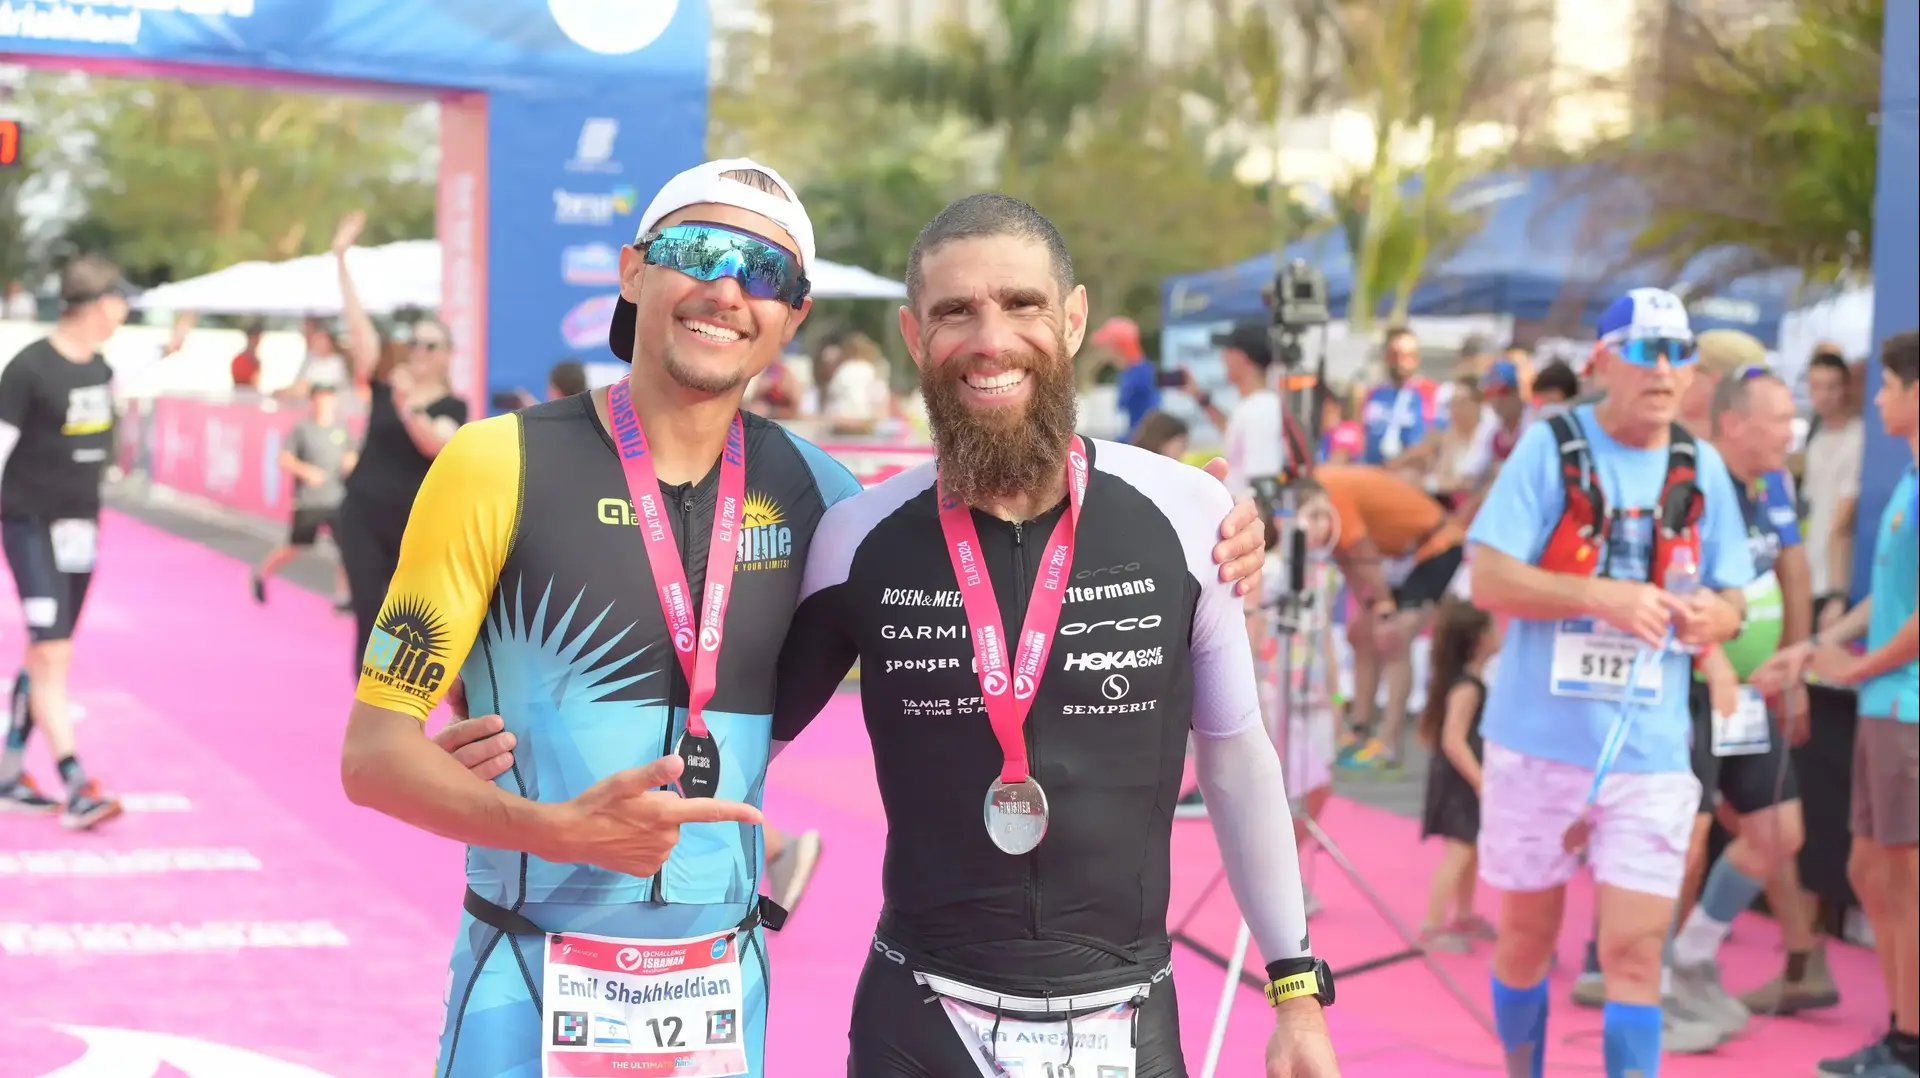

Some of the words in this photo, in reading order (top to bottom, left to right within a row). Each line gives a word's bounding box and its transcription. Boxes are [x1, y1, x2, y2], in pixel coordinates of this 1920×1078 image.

[641, 494, 658, 517] 2024
[723, 496, 736, 519] 2024
[648, 515, 665, 542] EILAT
[720, 517, 734, 542] EILAT
[957, 541, 974, 563] 2024
[1051, 545, 1068, 567] 2024
[743, 561, 761, 571] YOUR
[963, 563, 980, 586] EILAT
[1076, 562, 1140, 579] orca
[1045, 567, 1060, 590] EILAT
[669, 582, 688, 627] ISRAMAN
[710, 583, 724, 627] ISRAMAN
[881, 625, 967, 639] GARMI
[1060, 614, 1162, 635] orca
[984, 625, 1001, 669] ISRAMAN
[1025, 631, 1046, 676] ISRAMAN
[885, 658, 960, 673] SPONSER
[1063, 650, 1138, 671] HOKA
[1136, 647, 1162, 658] ONE
[1138, 655, 1164, 667] ONE
[375, 673, 394, 686] YOUR
[902, 699, 950, 707] TAMIR
[957, 696, 984, 706] KFI
[1063, 700, 1157, 715] SEMPERIT
[643, 956, 685, 969] ISRAMAN
[650, 949, 687, 957] CHALLENGE
[558, 974, 598, 999] Emil
[605, 975, 731, 1005] Shakhkeldian
[646, 1016, 686, 1048] 12
[612, 1061, 628, 1069] THE
[630, 1061, 674, 1069] ULTIMAT
